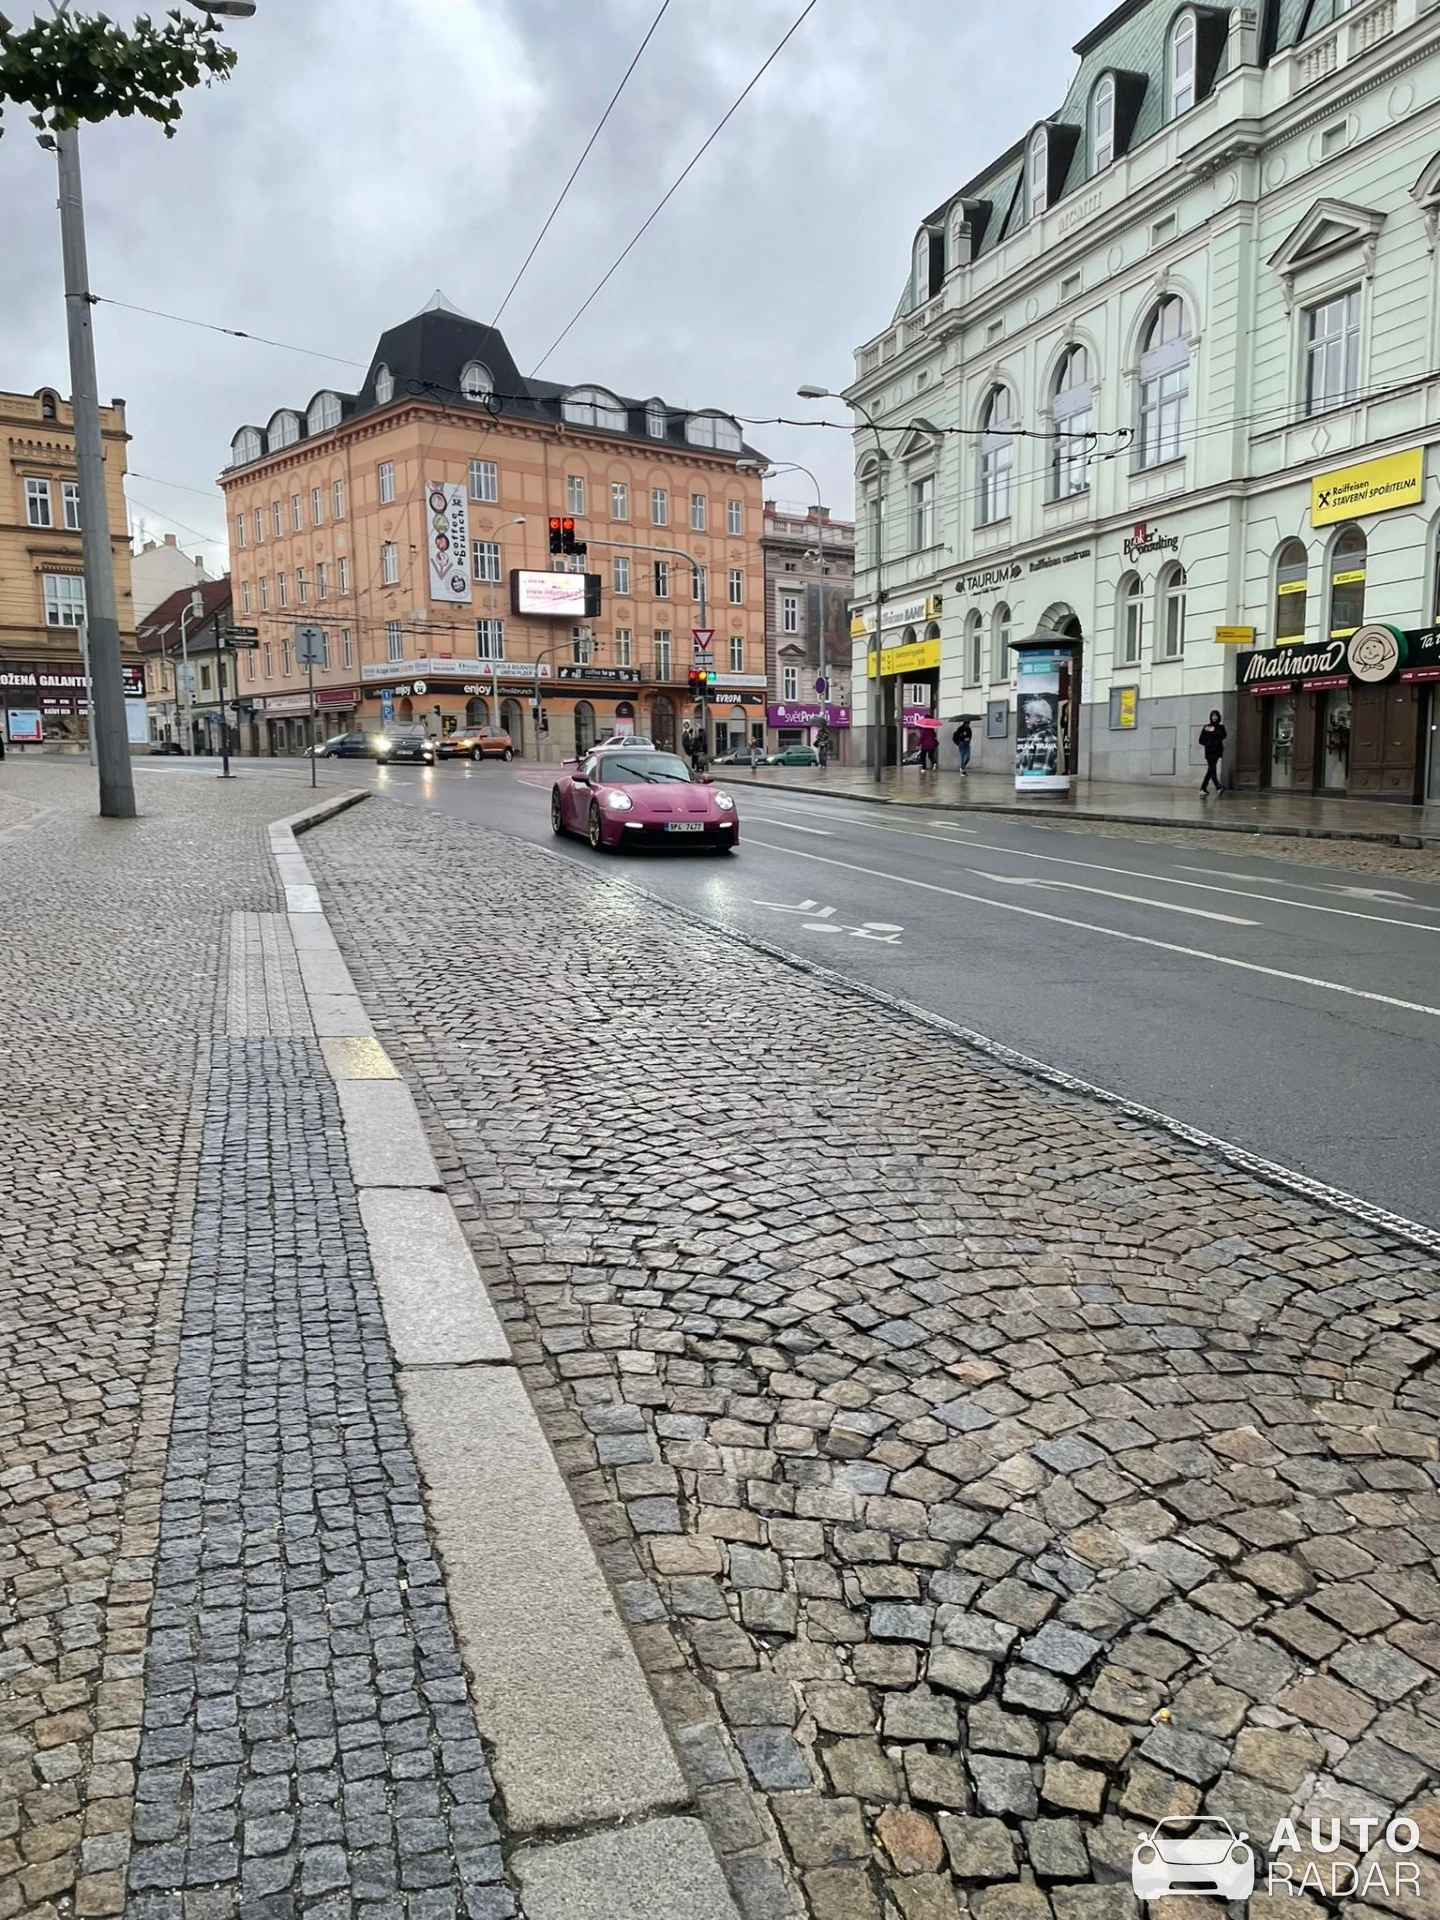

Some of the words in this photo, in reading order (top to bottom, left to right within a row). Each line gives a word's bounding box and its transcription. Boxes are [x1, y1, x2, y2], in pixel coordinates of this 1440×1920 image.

[1332, 481, 1369, 496] Raiffeisen
[1332, 490, 1368, 507] STAVEBNÍ
[1369, 478, 1416, 498] SPOŘITELNA
[1123, 528, 1155, 555] Broker
[1130, 535, 1178, 563] Consulting
[967, 566, 1009, 590] TAURUM
[904, 604, 925, 621] BANK
[1244, 641, 1345, 682] Malinová
[0, 672, 37, 686] OŽENÁ
[463, 683, 492, 696] enjoy
[715, 693, 742, 703] EVROPA
